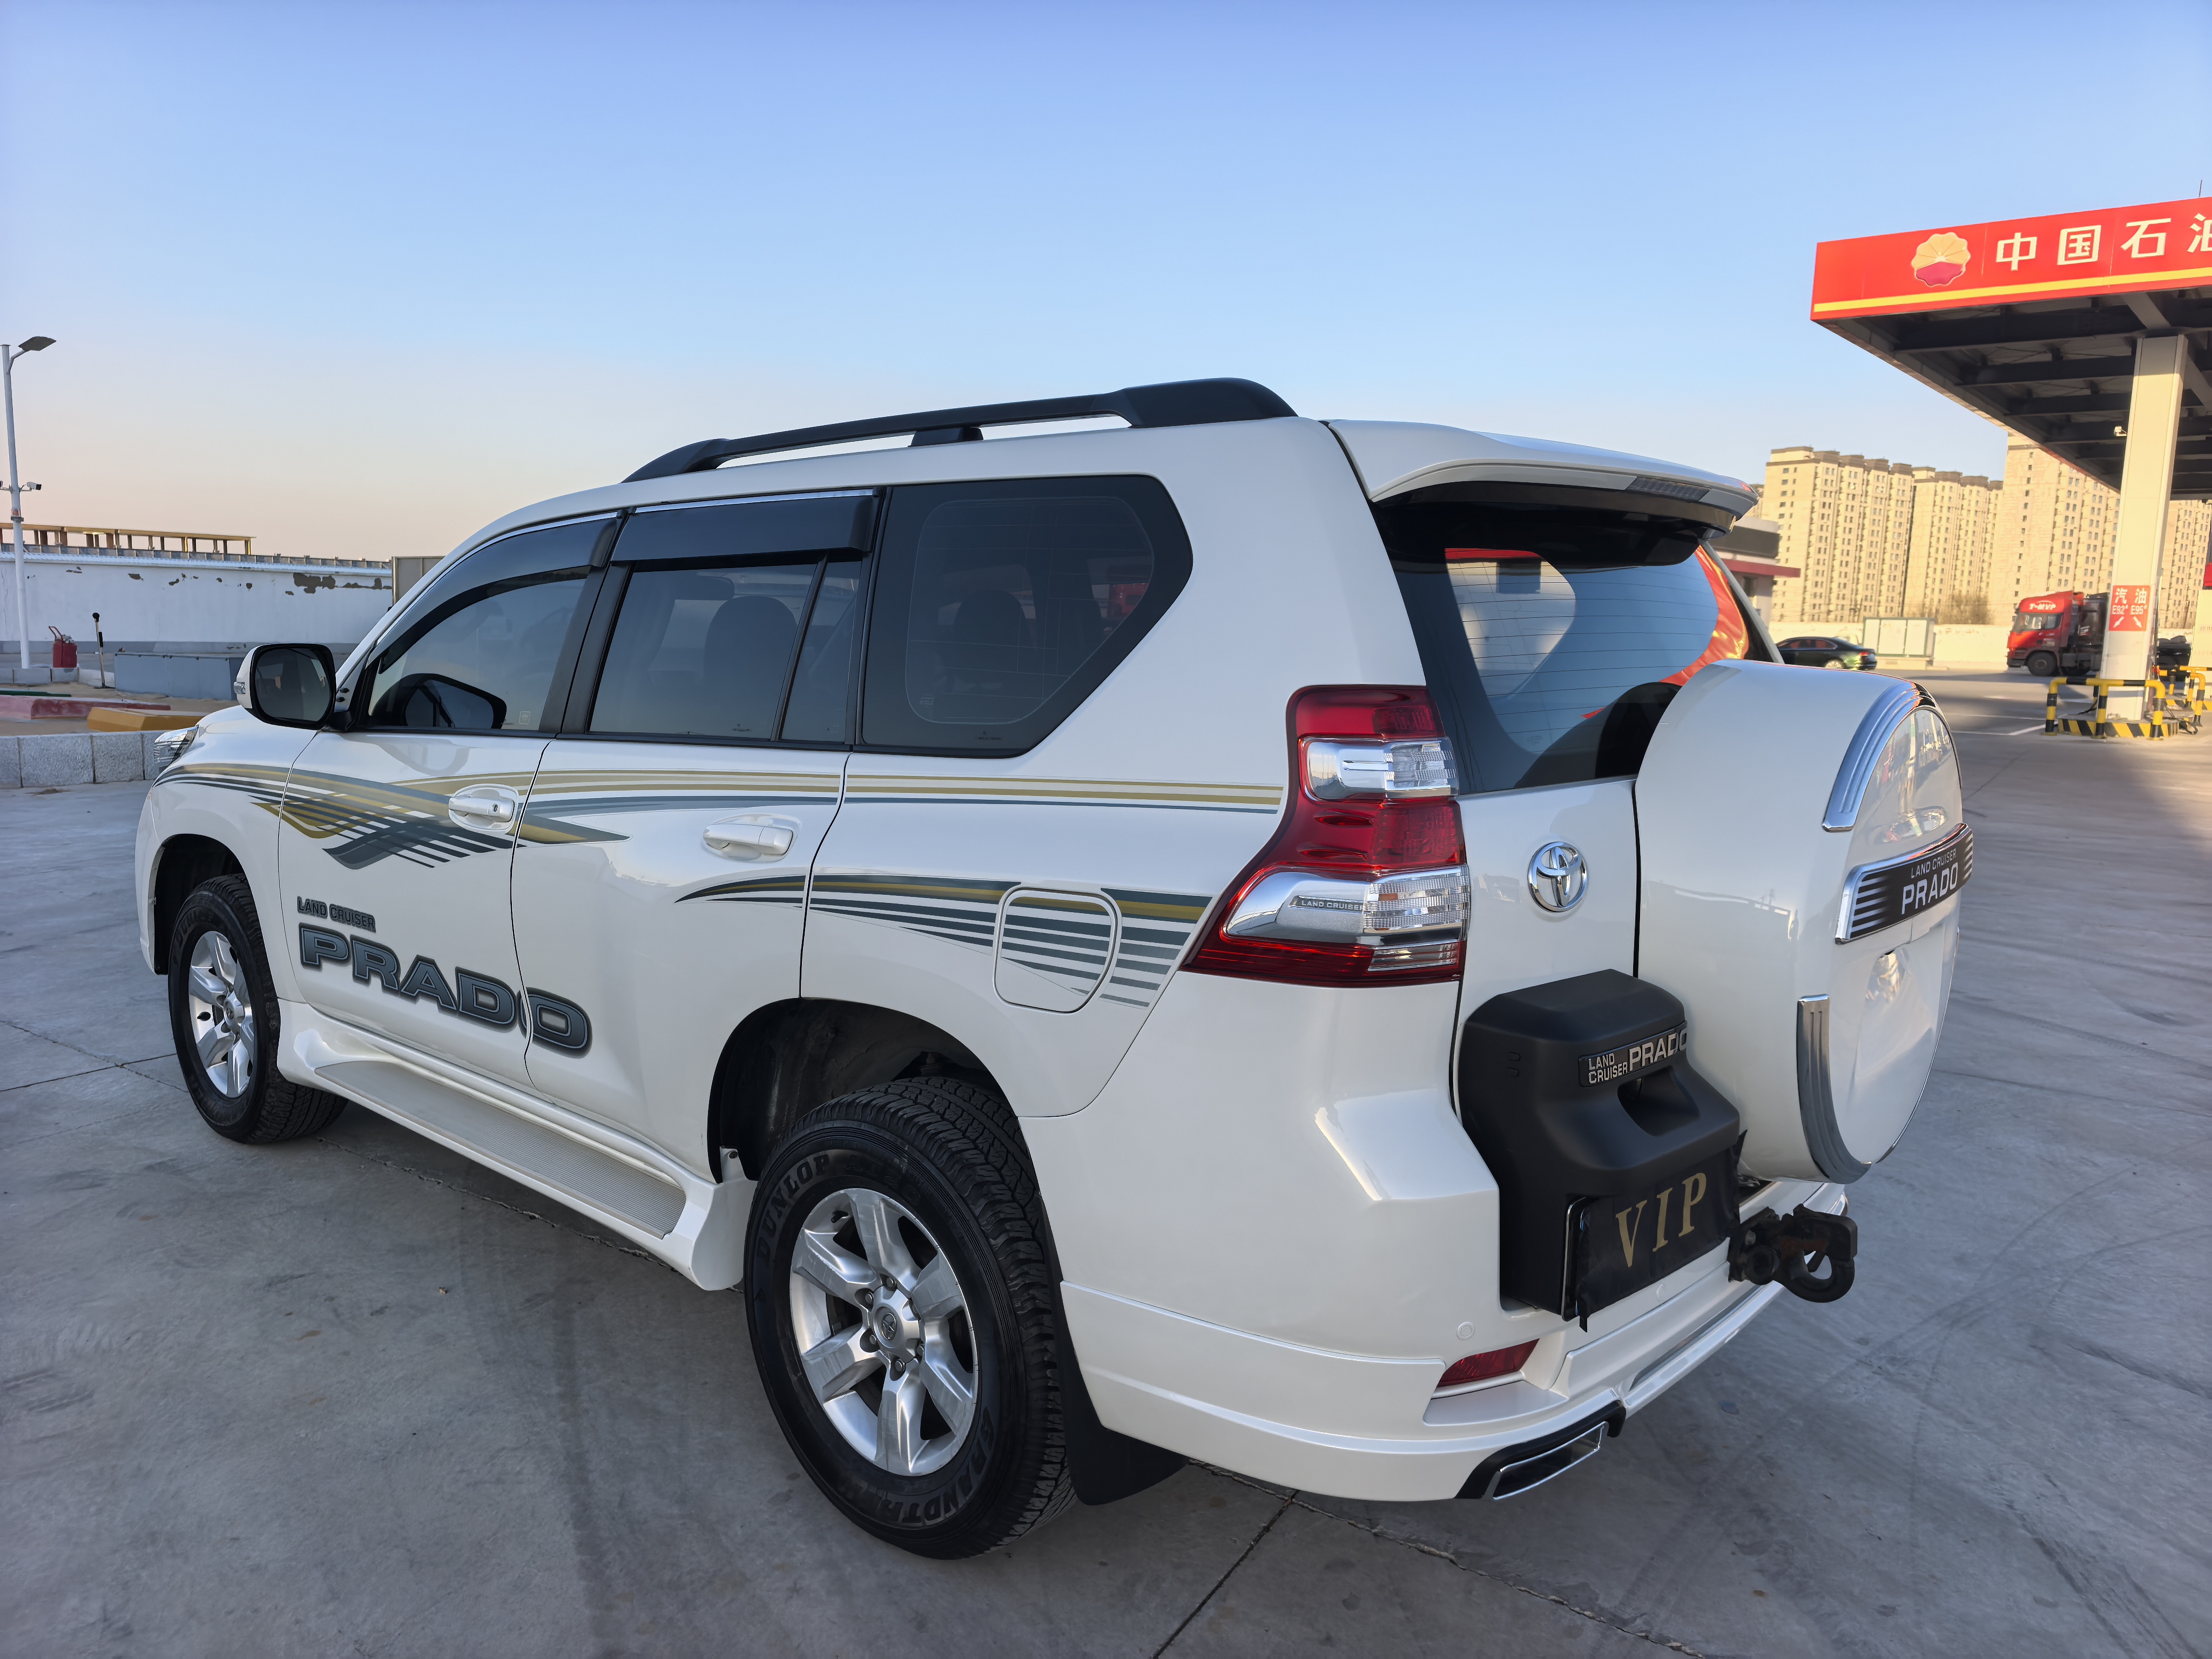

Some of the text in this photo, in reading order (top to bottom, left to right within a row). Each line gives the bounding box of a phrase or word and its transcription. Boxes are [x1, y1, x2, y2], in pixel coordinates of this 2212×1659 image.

[2115, 588, 2147, 604] 汽油
[1911, 848, 1957, 879] LAND CRUISER
[1901, 862, 1958, 915] PRADO
[298, 896, 375, 932] LAND CRUISER
[299, 922, 592, 1058] PRADO
[1588, 1028, 1688, 1071] LAND PRADO
[1588, 1062, 1628, 1084] CRUISER
[757, 1154, 830, 1267] DUNLOP
[1616, 1172, 1707, 1267] VIP
